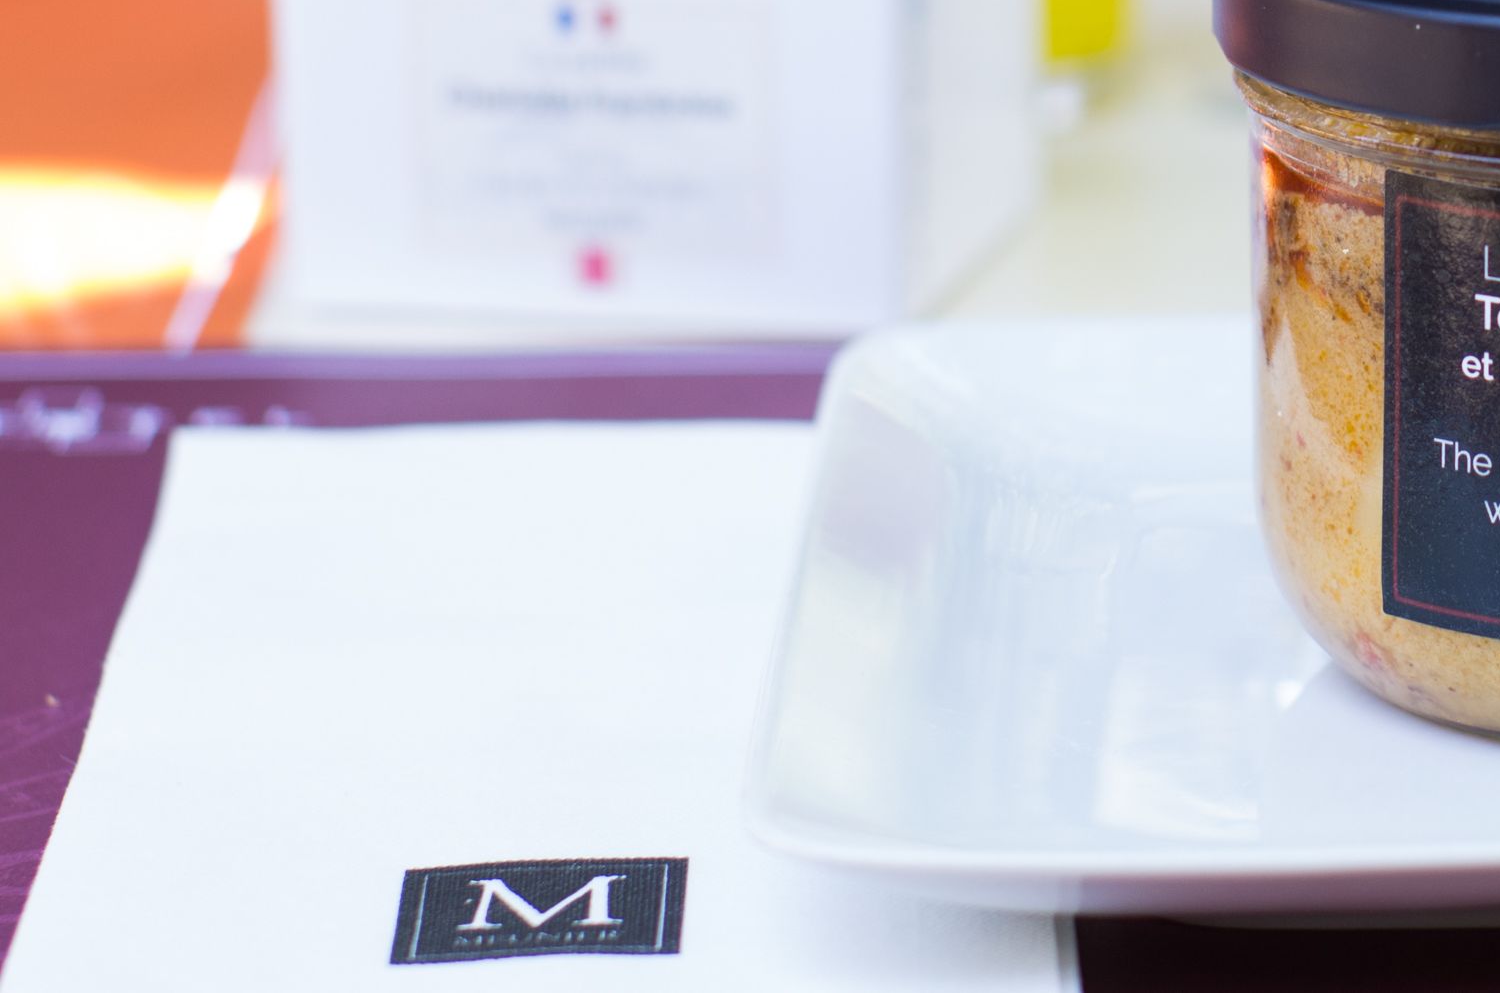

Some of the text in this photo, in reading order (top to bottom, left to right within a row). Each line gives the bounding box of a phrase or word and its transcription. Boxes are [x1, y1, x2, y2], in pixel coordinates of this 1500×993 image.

[1461, 351, 1493, 380] et
[1433, 438, 1492, 476] The
[456, 874, 627, 931] M
